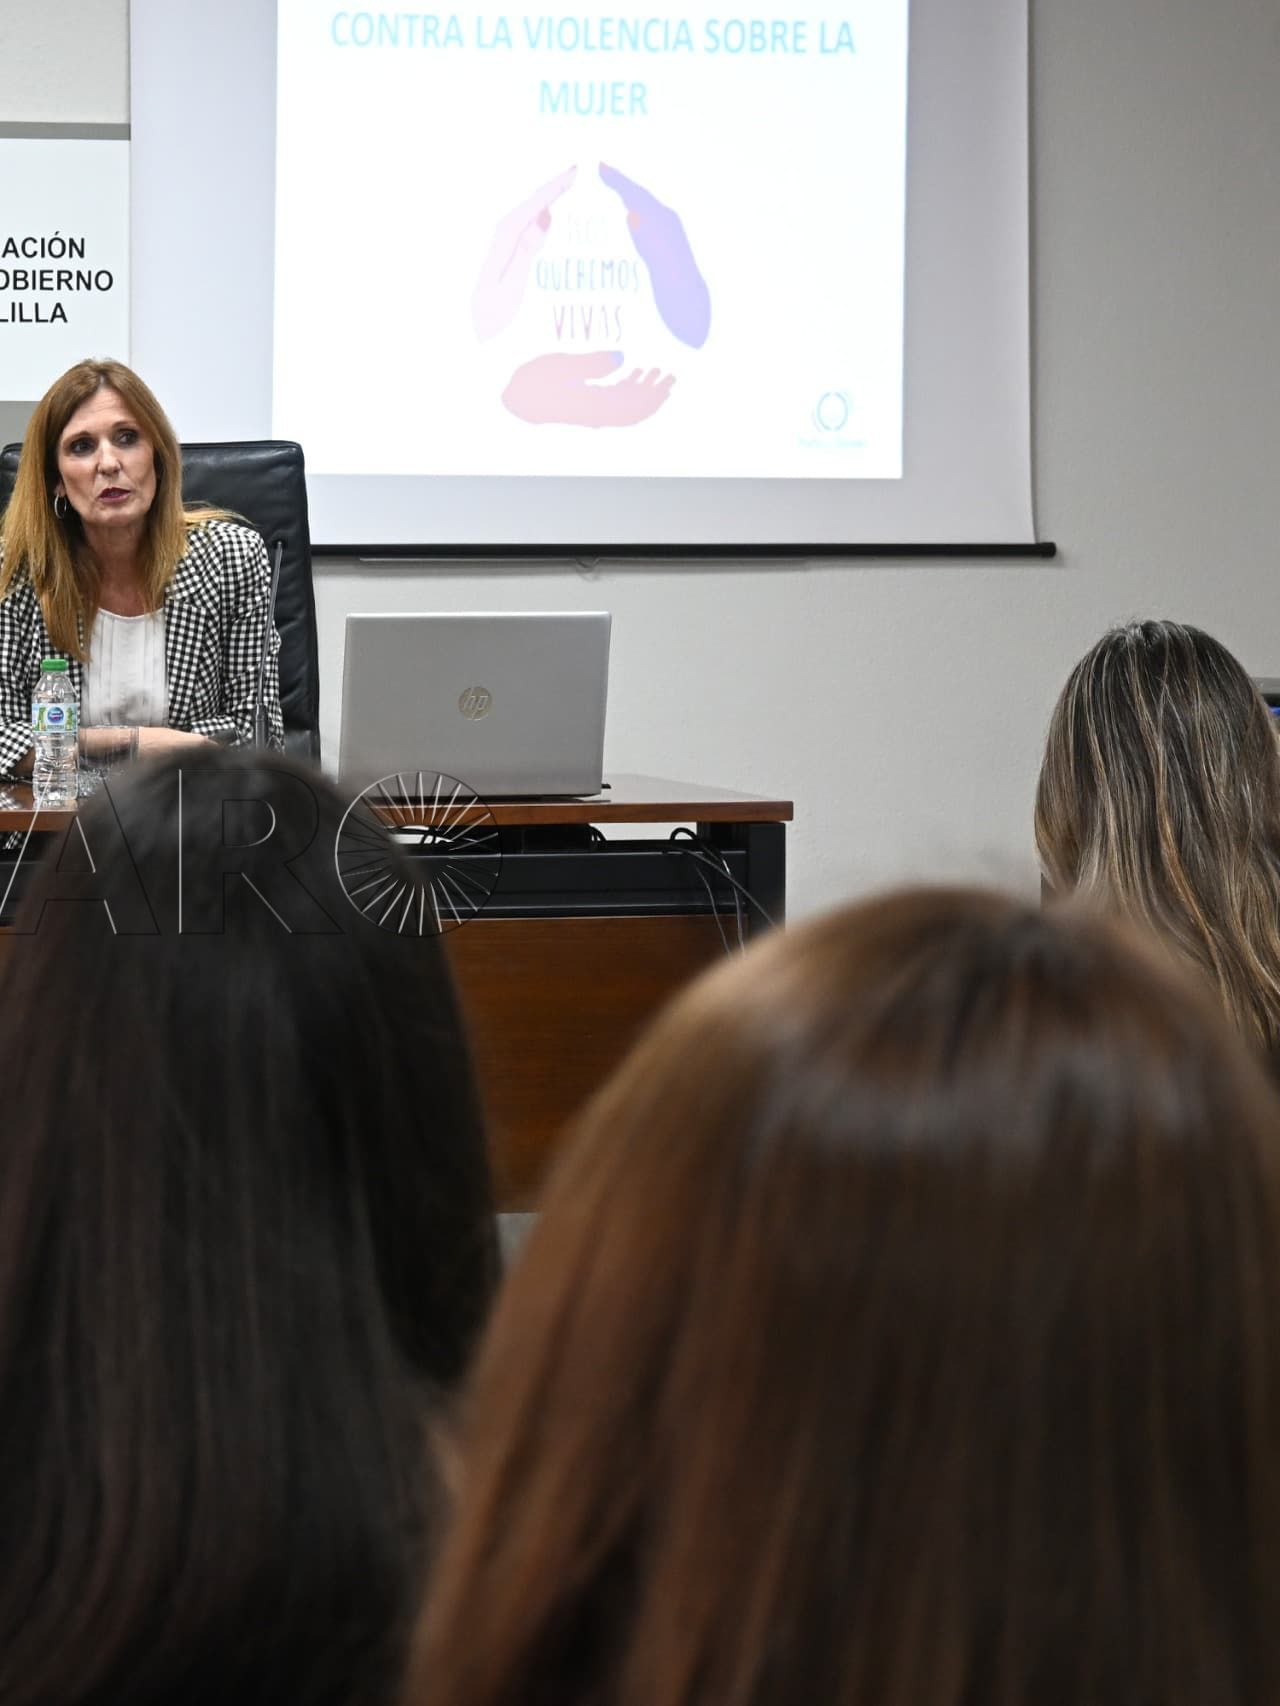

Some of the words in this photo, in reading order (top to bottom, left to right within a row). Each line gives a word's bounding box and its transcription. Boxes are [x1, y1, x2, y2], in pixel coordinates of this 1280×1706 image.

[330, 11, 463, 48] CONTRA
[475, 15, 513, 50] LA
[524, 15, 695, 54] VIOLENCIA
[703, 18, 807, 54] SOBRE
[818, 19, 856, 55] LA
[538, 80, 649, 116] MUJER
[567, 212, 610, 246] NO
[535, 257, 640, 294] QUEREMOS
[553, 304, 623, 342] VIVAS
